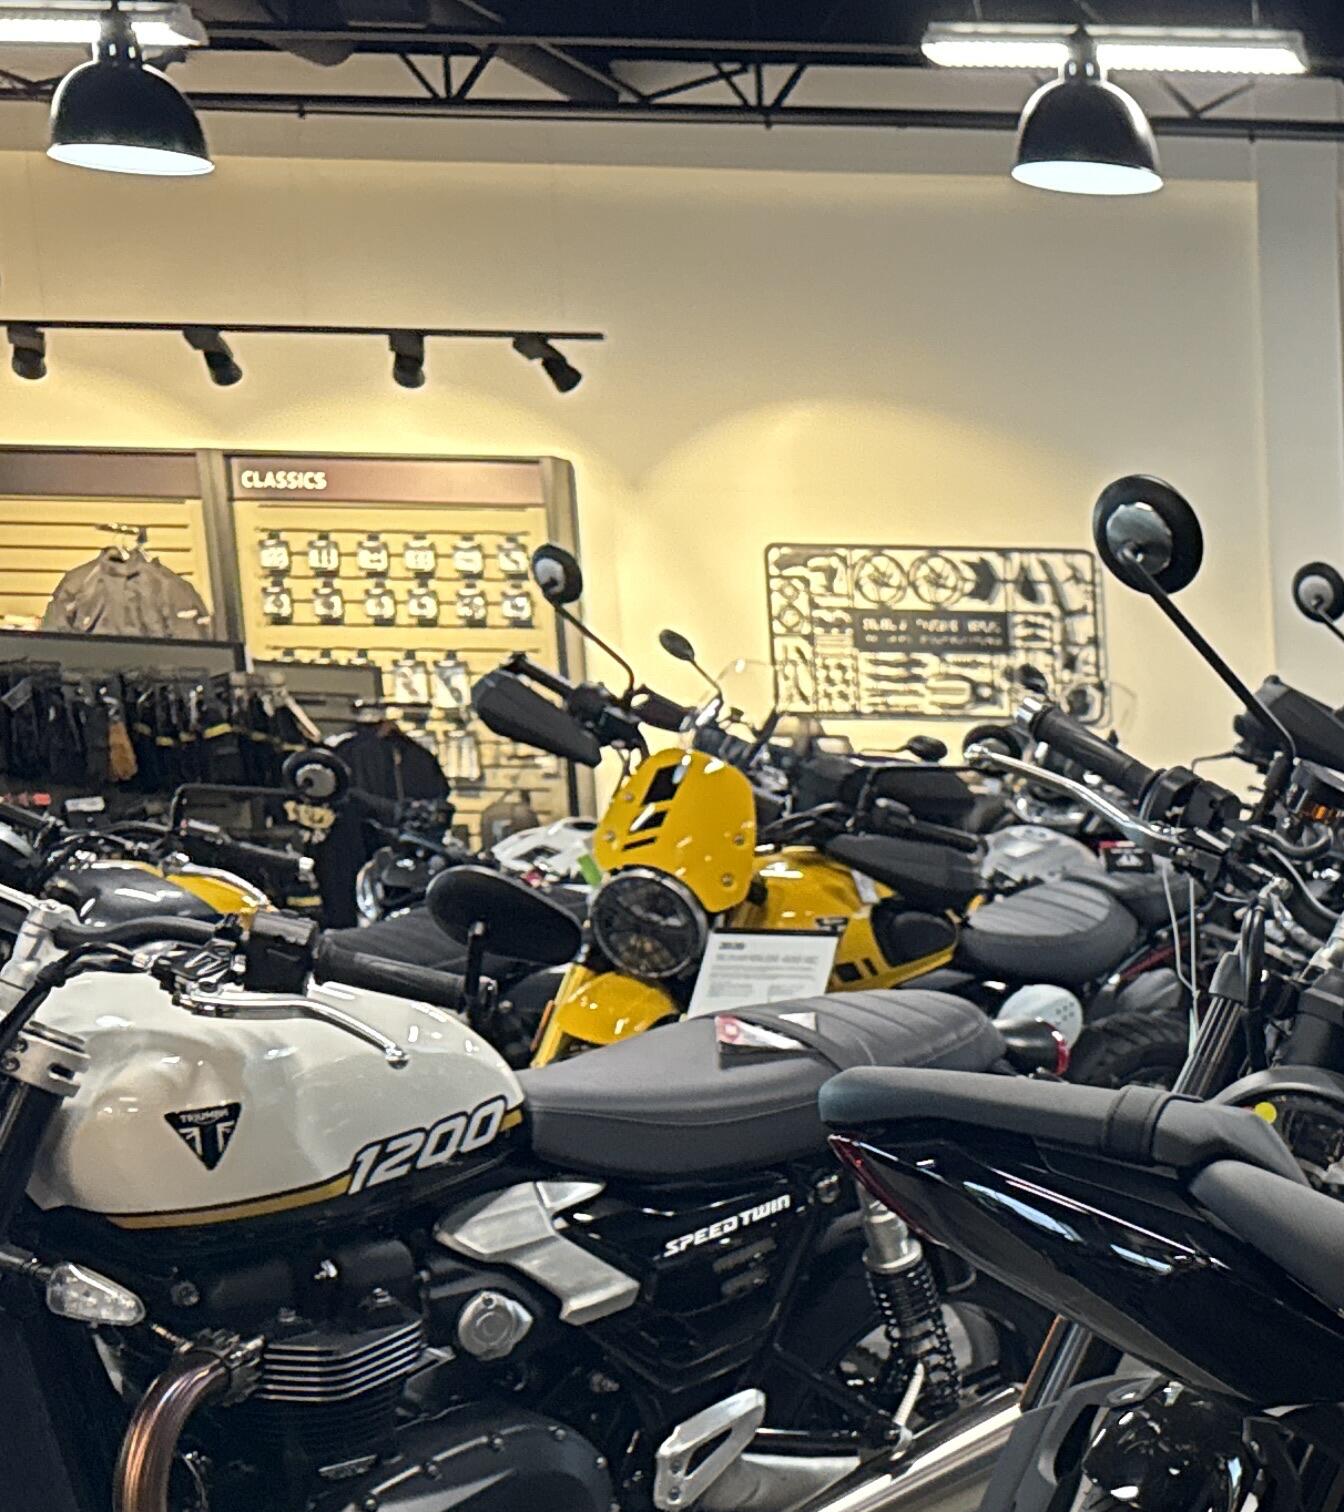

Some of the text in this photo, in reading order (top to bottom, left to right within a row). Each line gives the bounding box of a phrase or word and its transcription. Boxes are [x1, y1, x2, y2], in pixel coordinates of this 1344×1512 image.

[241, 470, 328, 490] CLASSICS
[347, 1095, 507, 1195] 1200
[663, 1194, 791, 1258] SPEED TWIN
